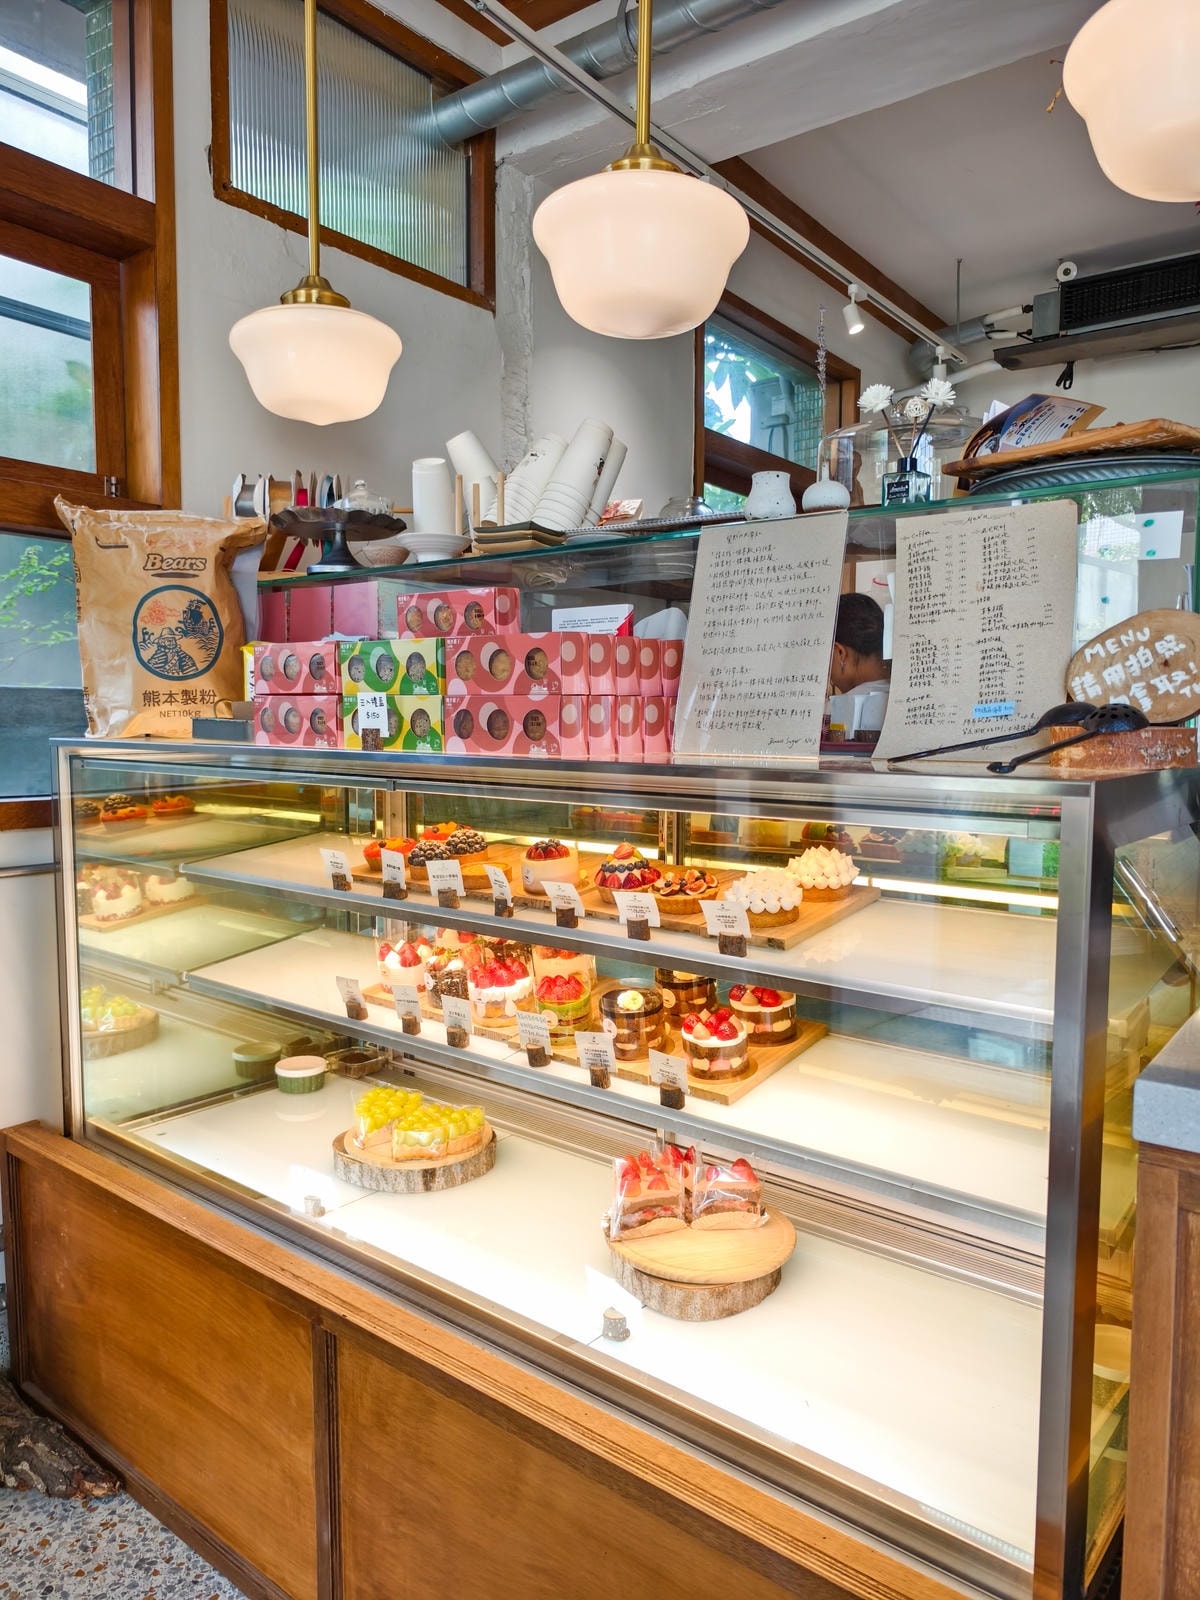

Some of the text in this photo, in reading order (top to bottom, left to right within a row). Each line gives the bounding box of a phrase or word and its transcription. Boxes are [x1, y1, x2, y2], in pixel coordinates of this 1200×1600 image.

[143, 553, 207, 571] Bears
[1084, 627, 1150, 663] MENU
[142, 689, 217, 707] 熊本製粉
[366, 711, 380, 720] $150
